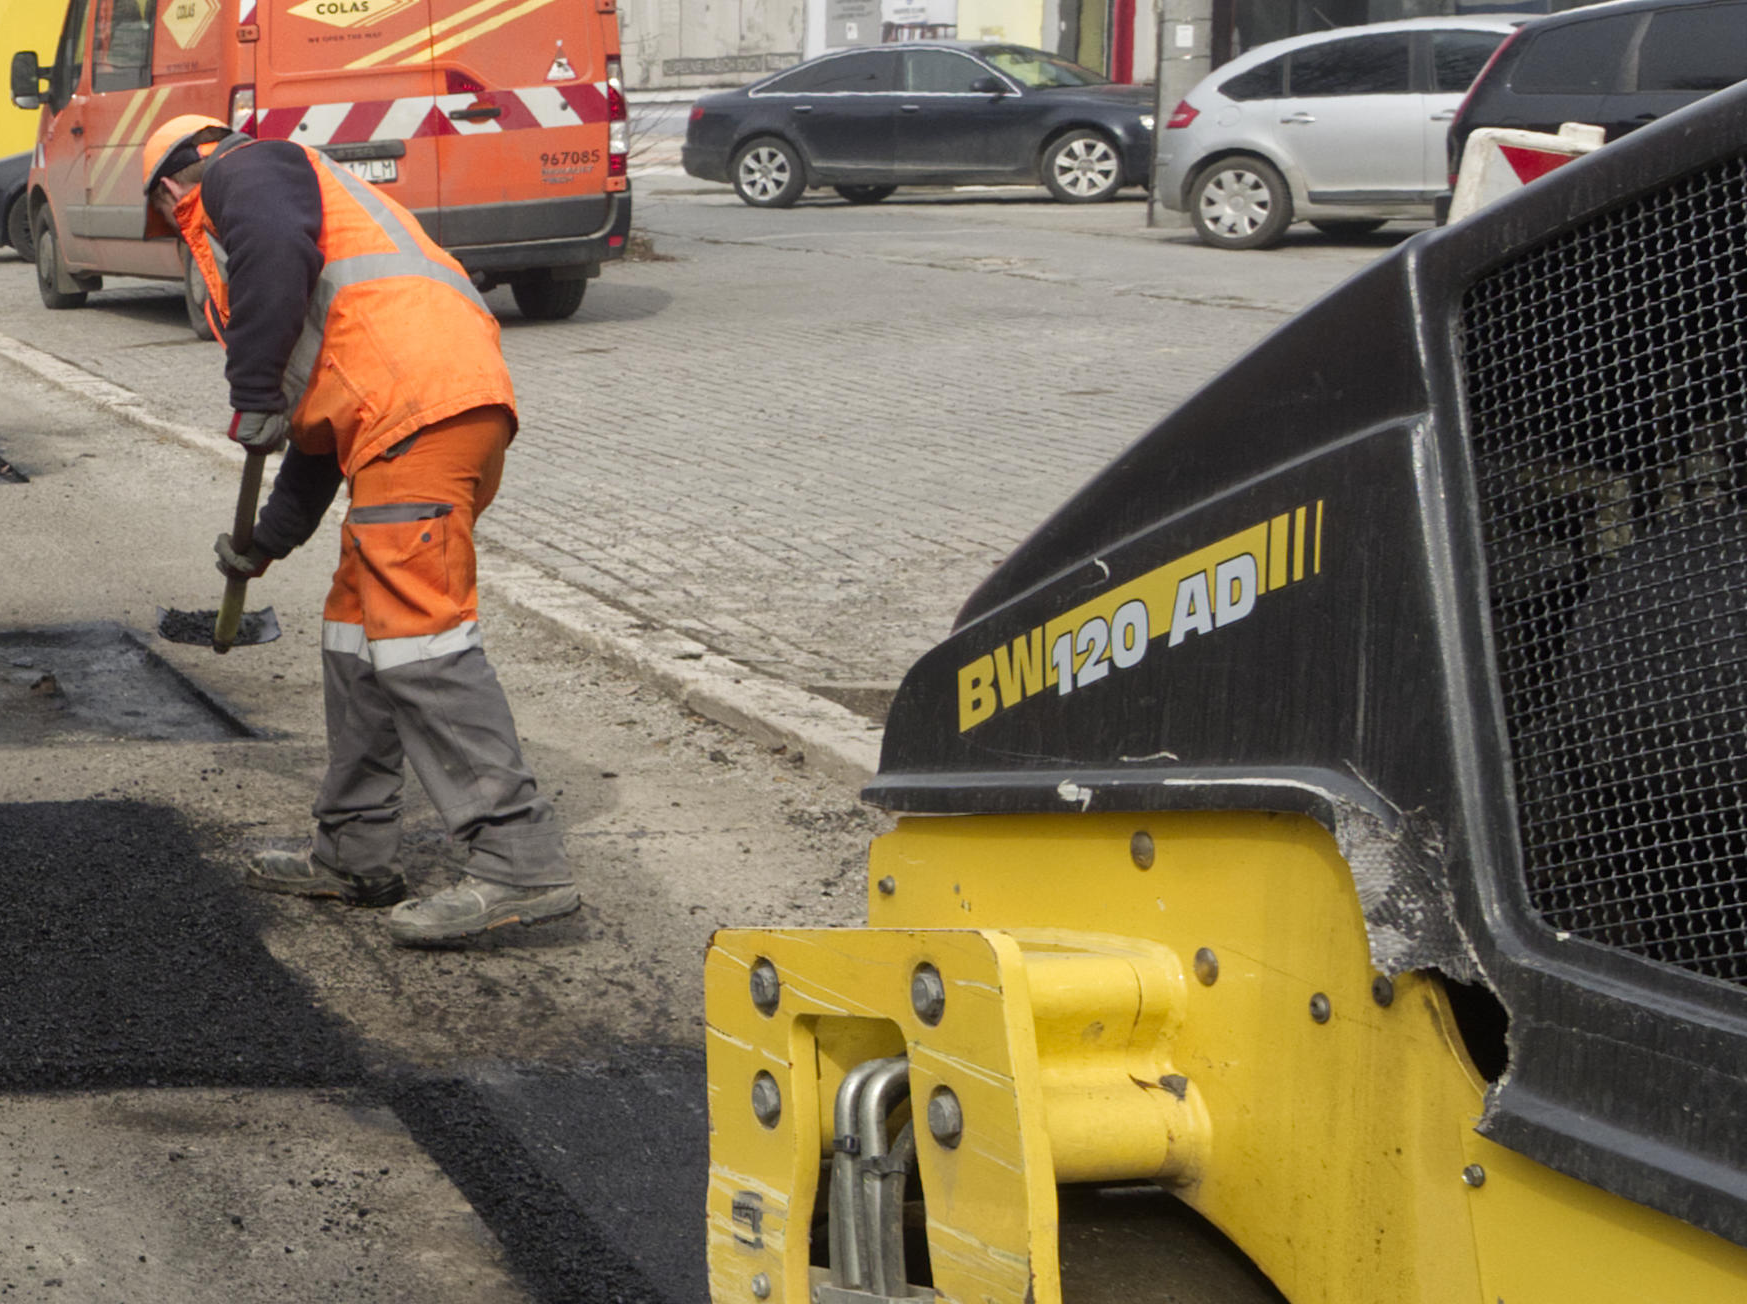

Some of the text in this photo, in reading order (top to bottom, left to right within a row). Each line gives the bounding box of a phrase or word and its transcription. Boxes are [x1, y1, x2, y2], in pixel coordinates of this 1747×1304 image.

[176, 2, 196, 20] COLAS
[316, 1, 369, 15] COLAS
[540, 149, 600, 167] 967085
[349, 161, 393, 179] 17LM
[1168, 552, 1258, 647] AD
